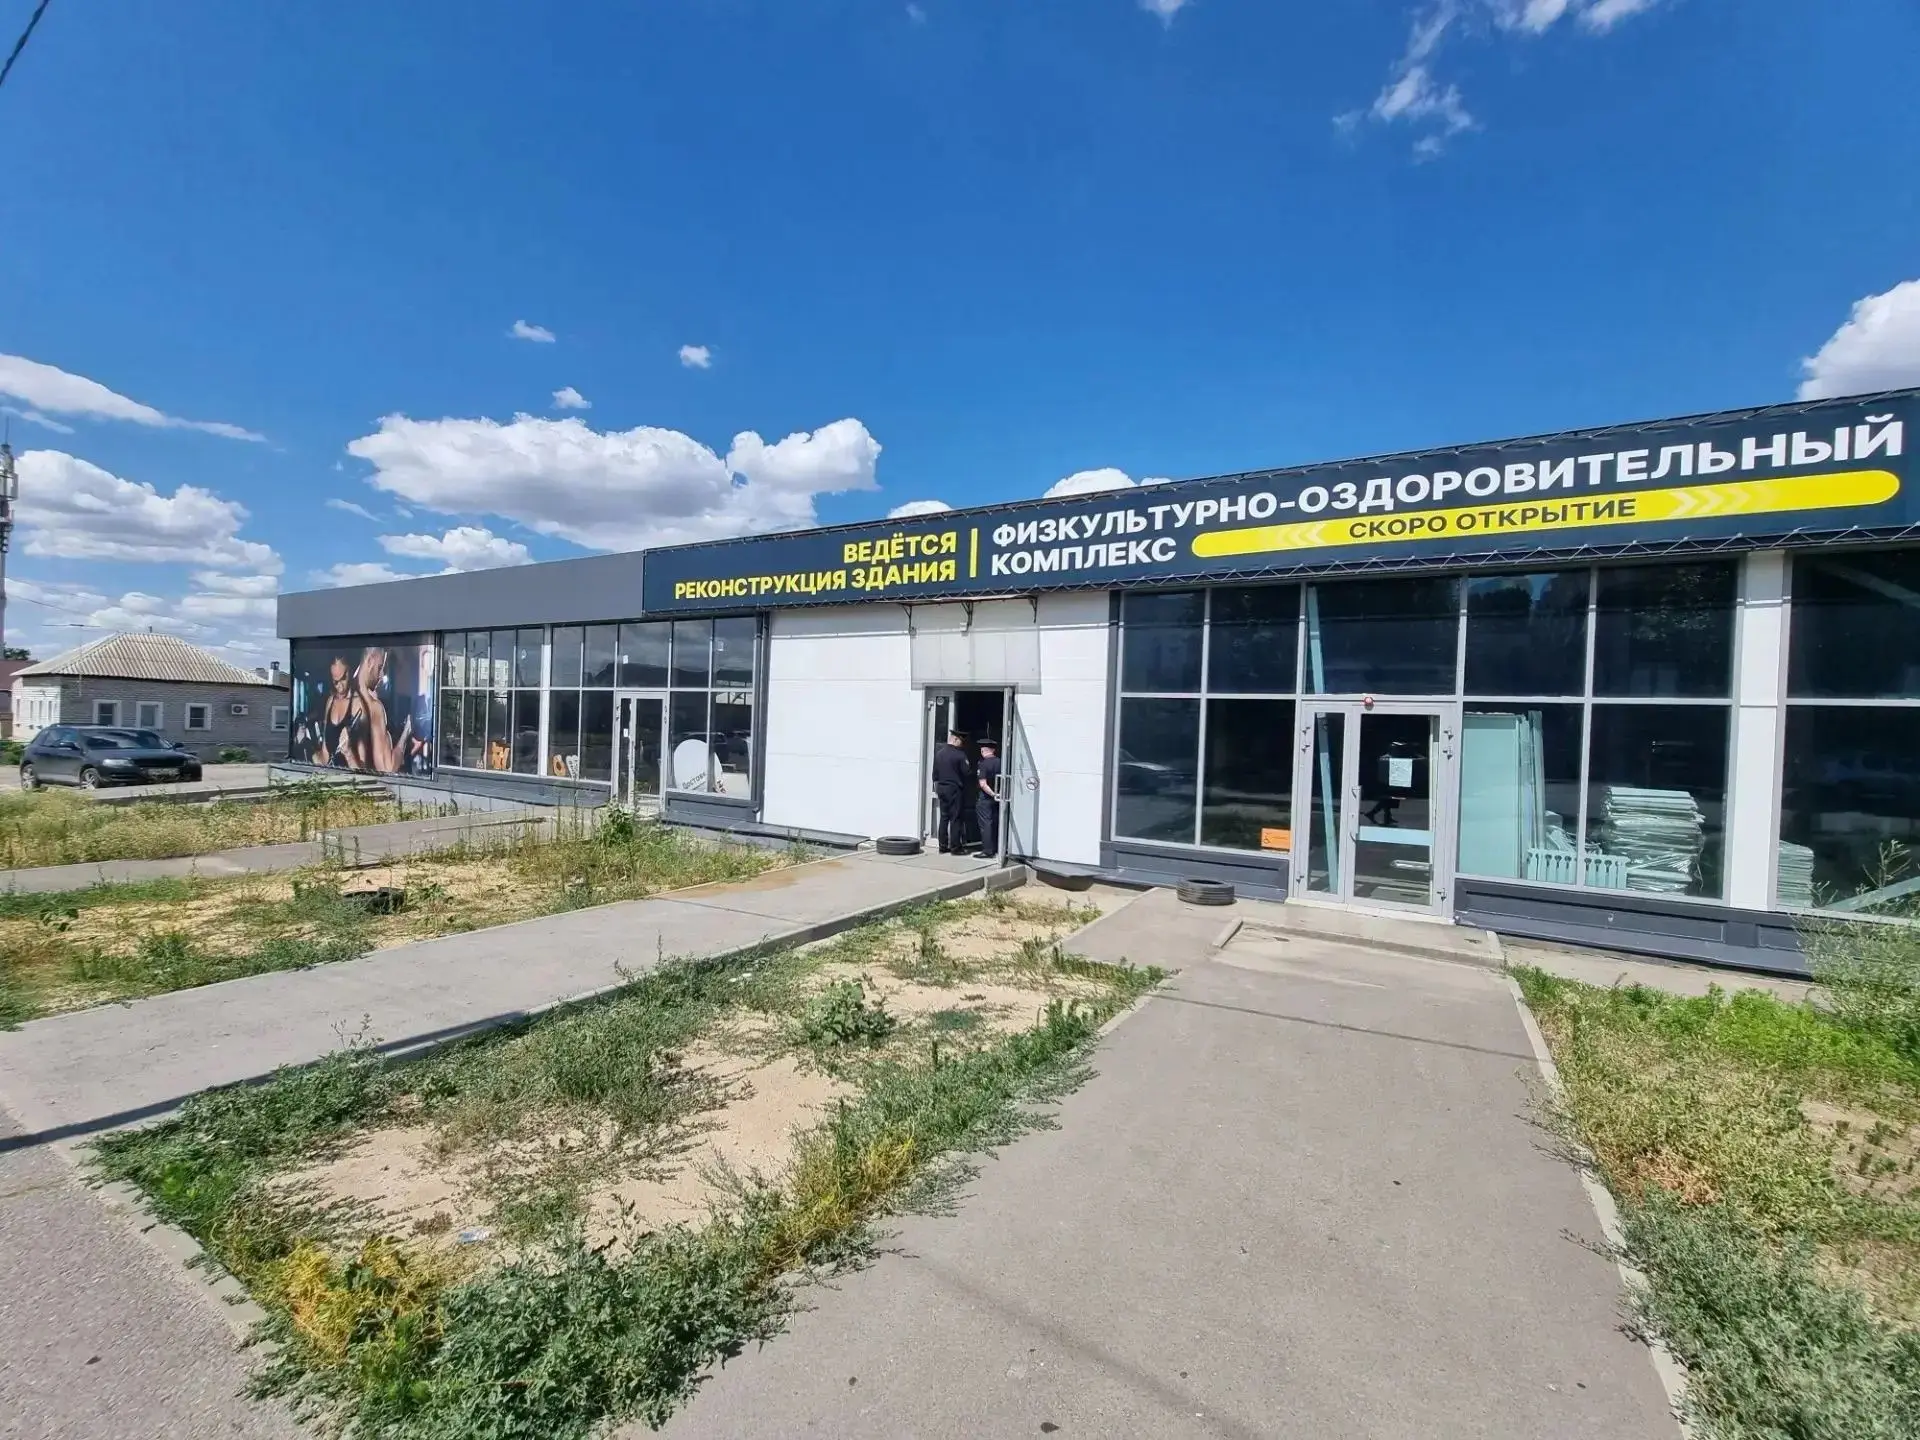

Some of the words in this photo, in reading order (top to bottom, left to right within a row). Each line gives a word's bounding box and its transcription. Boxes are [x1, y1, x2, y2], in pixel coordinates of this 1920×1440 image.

[992, 413, 1904, 548] ФИЗКУЛЬТУРНО-ОЗДОРОВИТЕЛЬНЫЙ
[1349, 515, 1447, 539] СКОРО
[1456, 499, 1636, 531] ОТКРЫТИЕ
[844, 531, 957, 564] ВЕДЁТСЯ
[991, 537, 1177, 576] КОМПЛЕКС
[675, 569, 847, 600] РЕКОНСТРУКЦИЯ
[851, 559, 956, 590] ЗДАНИЯ
